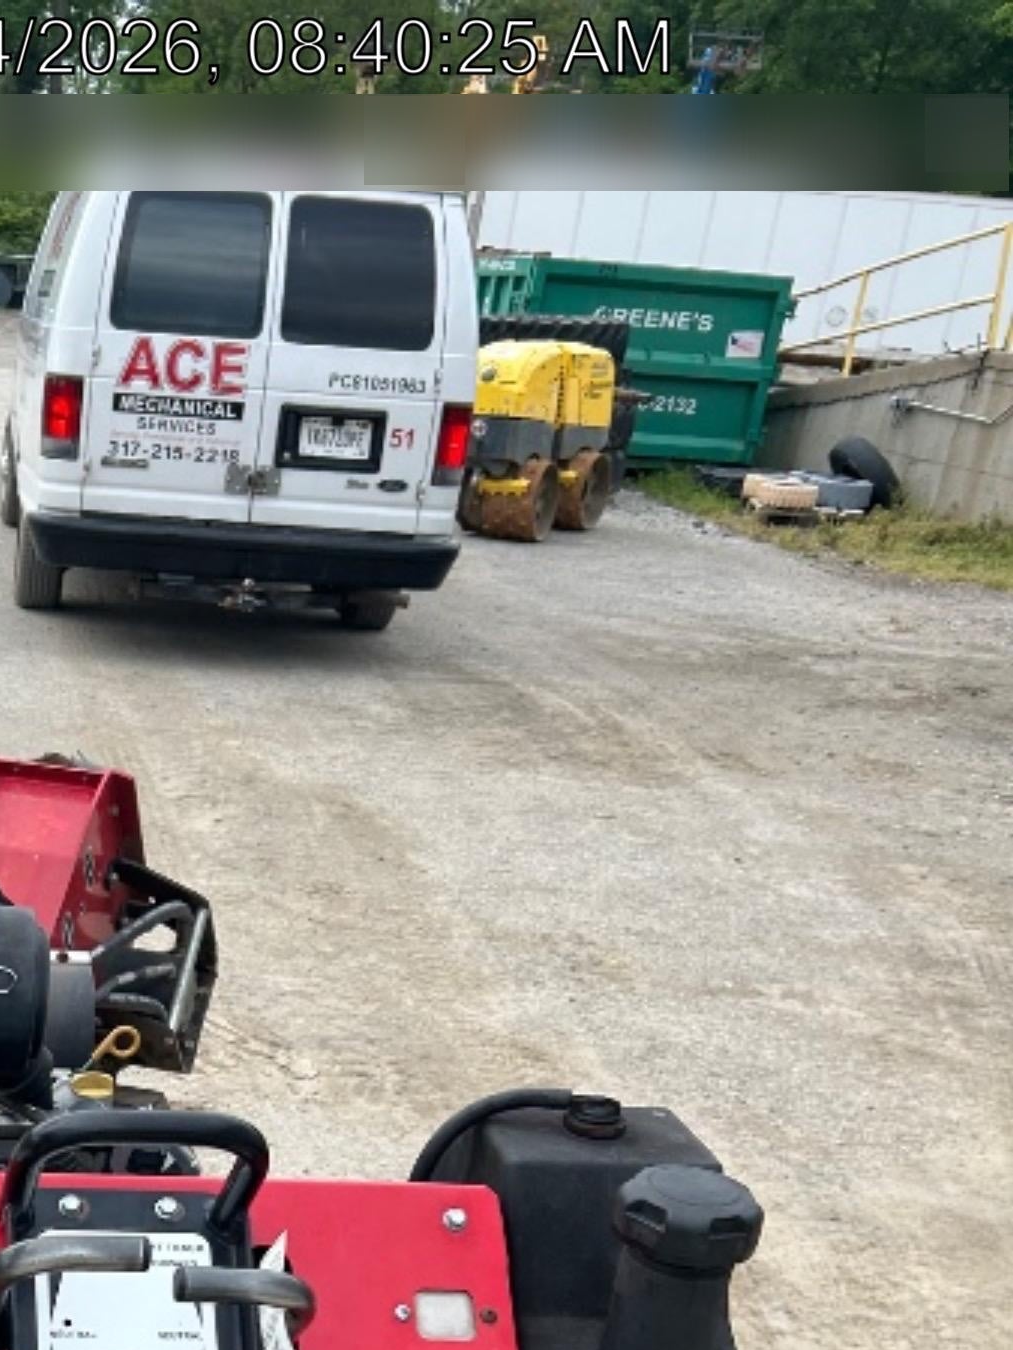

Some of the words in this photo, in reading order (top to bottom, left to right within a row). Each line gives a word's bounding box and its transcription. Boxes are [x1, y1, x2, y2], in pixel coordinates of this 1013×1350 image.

[118, 336, 246, 394] ACE
[117, 395, 237, 418] MECHANICAL
[137, 416, 216, 435] SERVICES
[389, 428, 414, 450] 51
